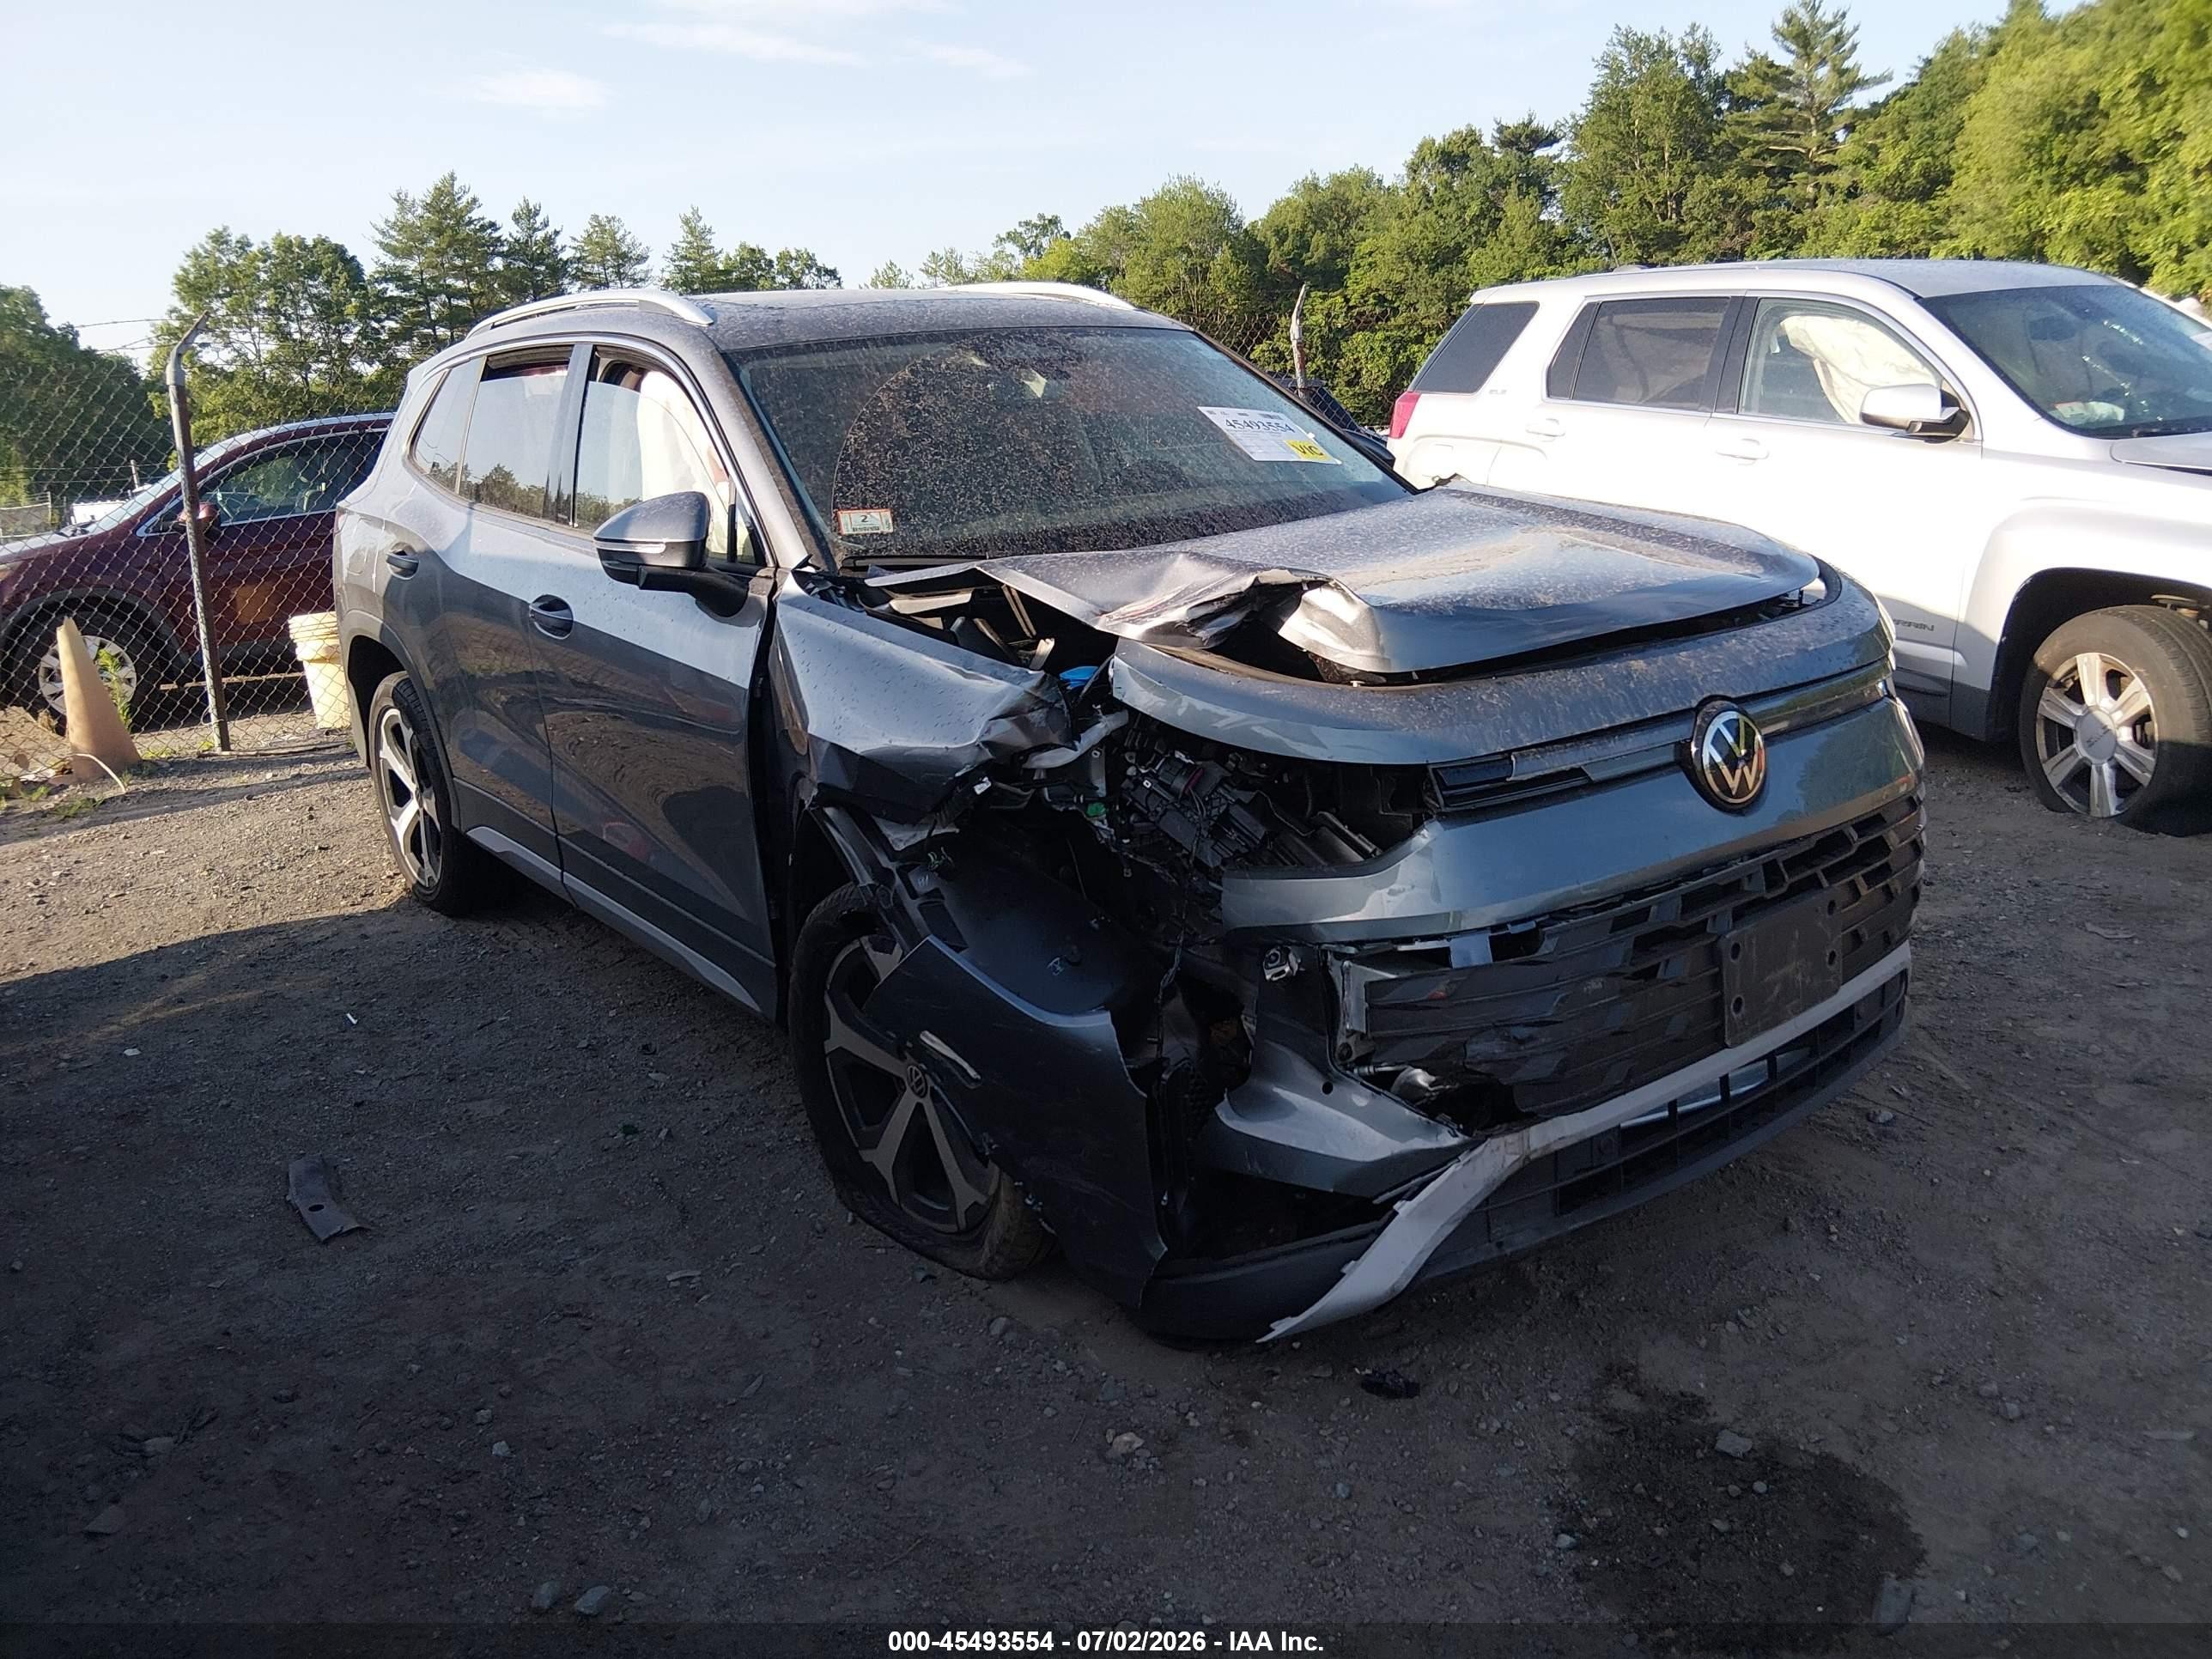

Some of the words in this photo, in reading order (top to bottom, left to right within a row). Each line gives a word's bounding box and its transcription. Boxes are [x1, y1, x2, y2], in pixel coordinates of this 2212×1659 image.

[1225, 418, 1296, 433] 45493554
[860, 514, 869, 523] 2
[1702, 711, 1765, 803] VW
